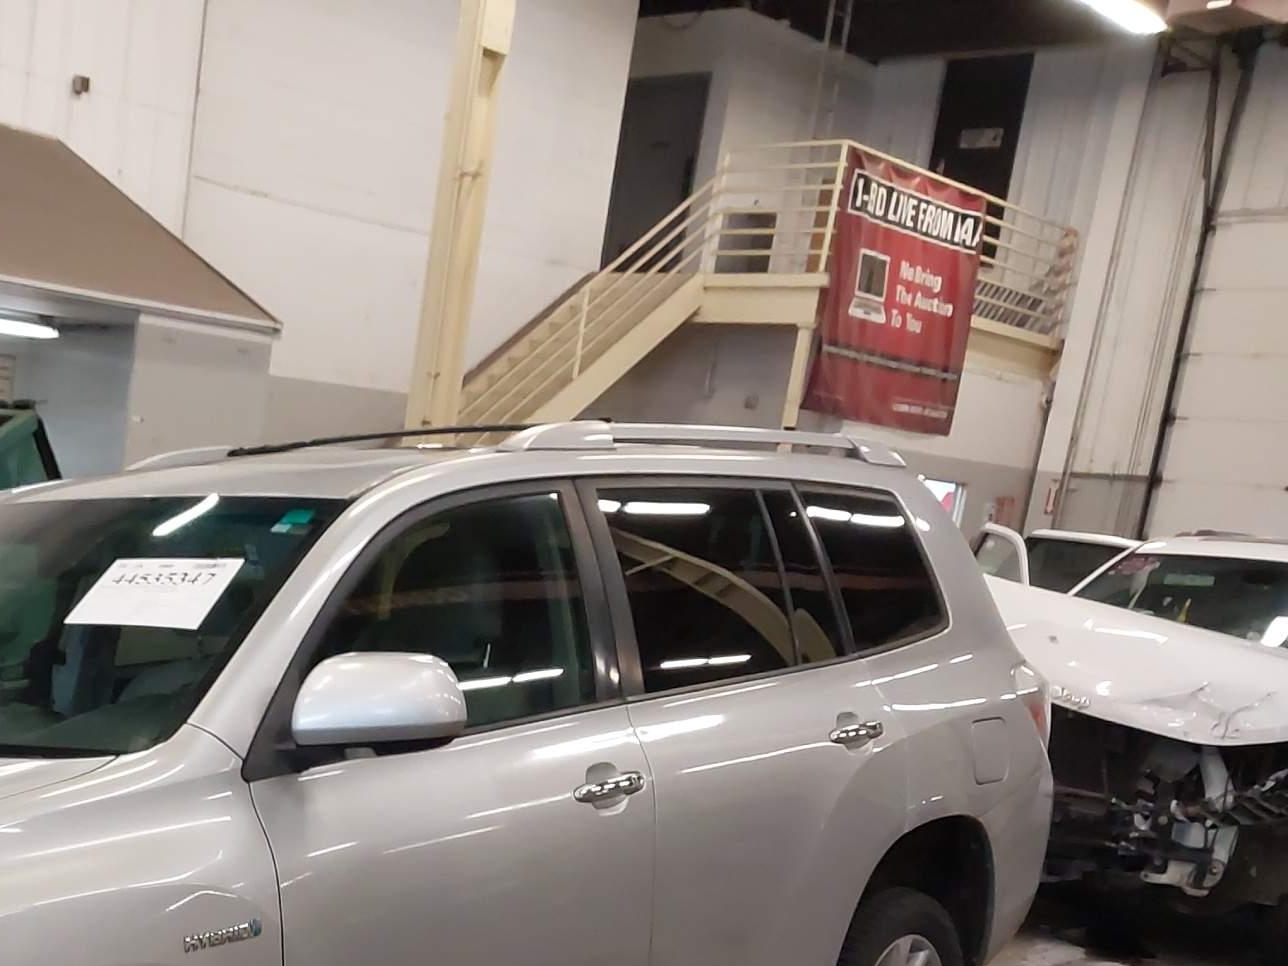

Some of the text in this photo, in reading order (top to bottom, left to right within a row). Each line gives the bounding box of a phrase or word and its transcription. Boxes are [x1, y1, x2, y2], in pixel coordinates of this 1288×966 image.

[888, 190, 916, 228] LIVE
[917, 203, 954, 243] FROM
[112, 571, 218, 586] 44535347
[183, 922, 250, 953] HYBRID
